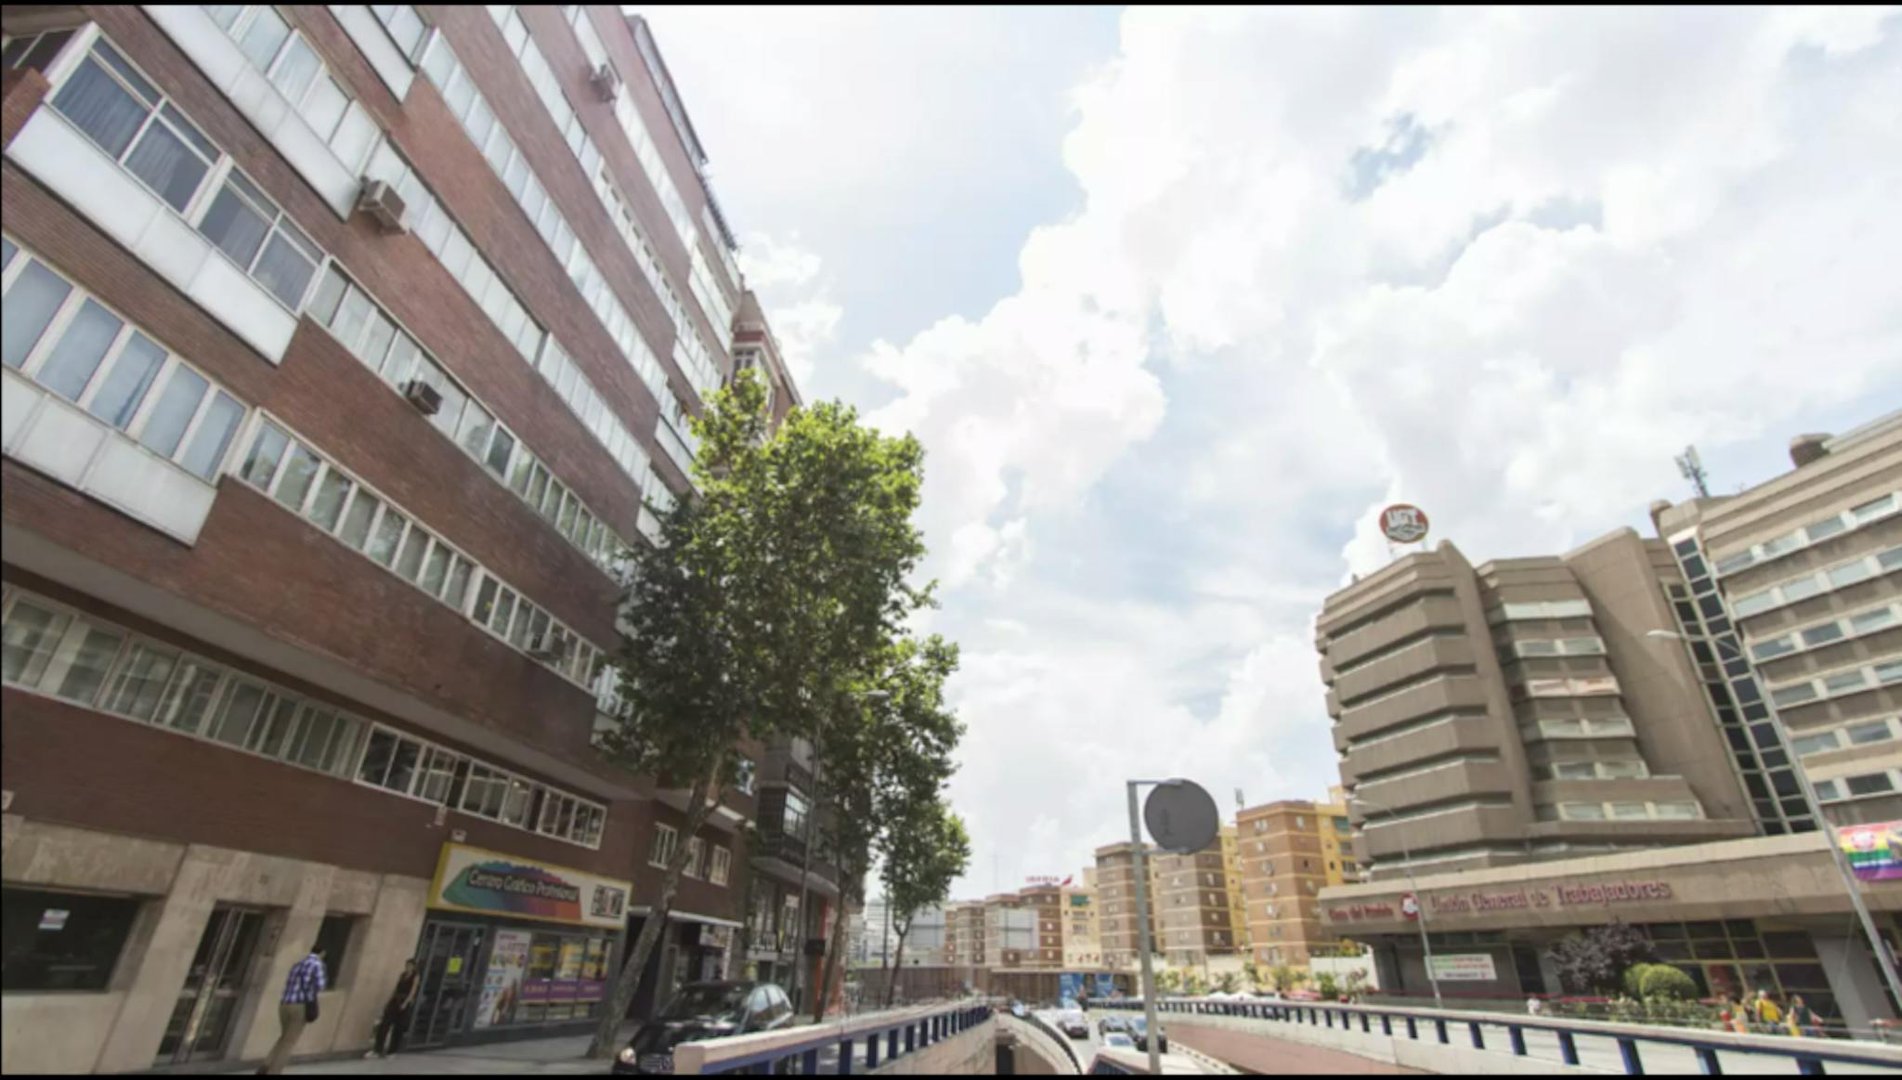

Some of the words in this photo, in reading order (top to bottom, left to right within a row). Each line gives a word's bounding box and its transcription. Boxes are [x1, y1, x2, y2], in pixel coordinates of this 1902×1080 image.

[469, 868, 503, 890] Centro
[1470, 888, 1528, 911] General
[1551, 879, 1673, 907] Trabajadores
